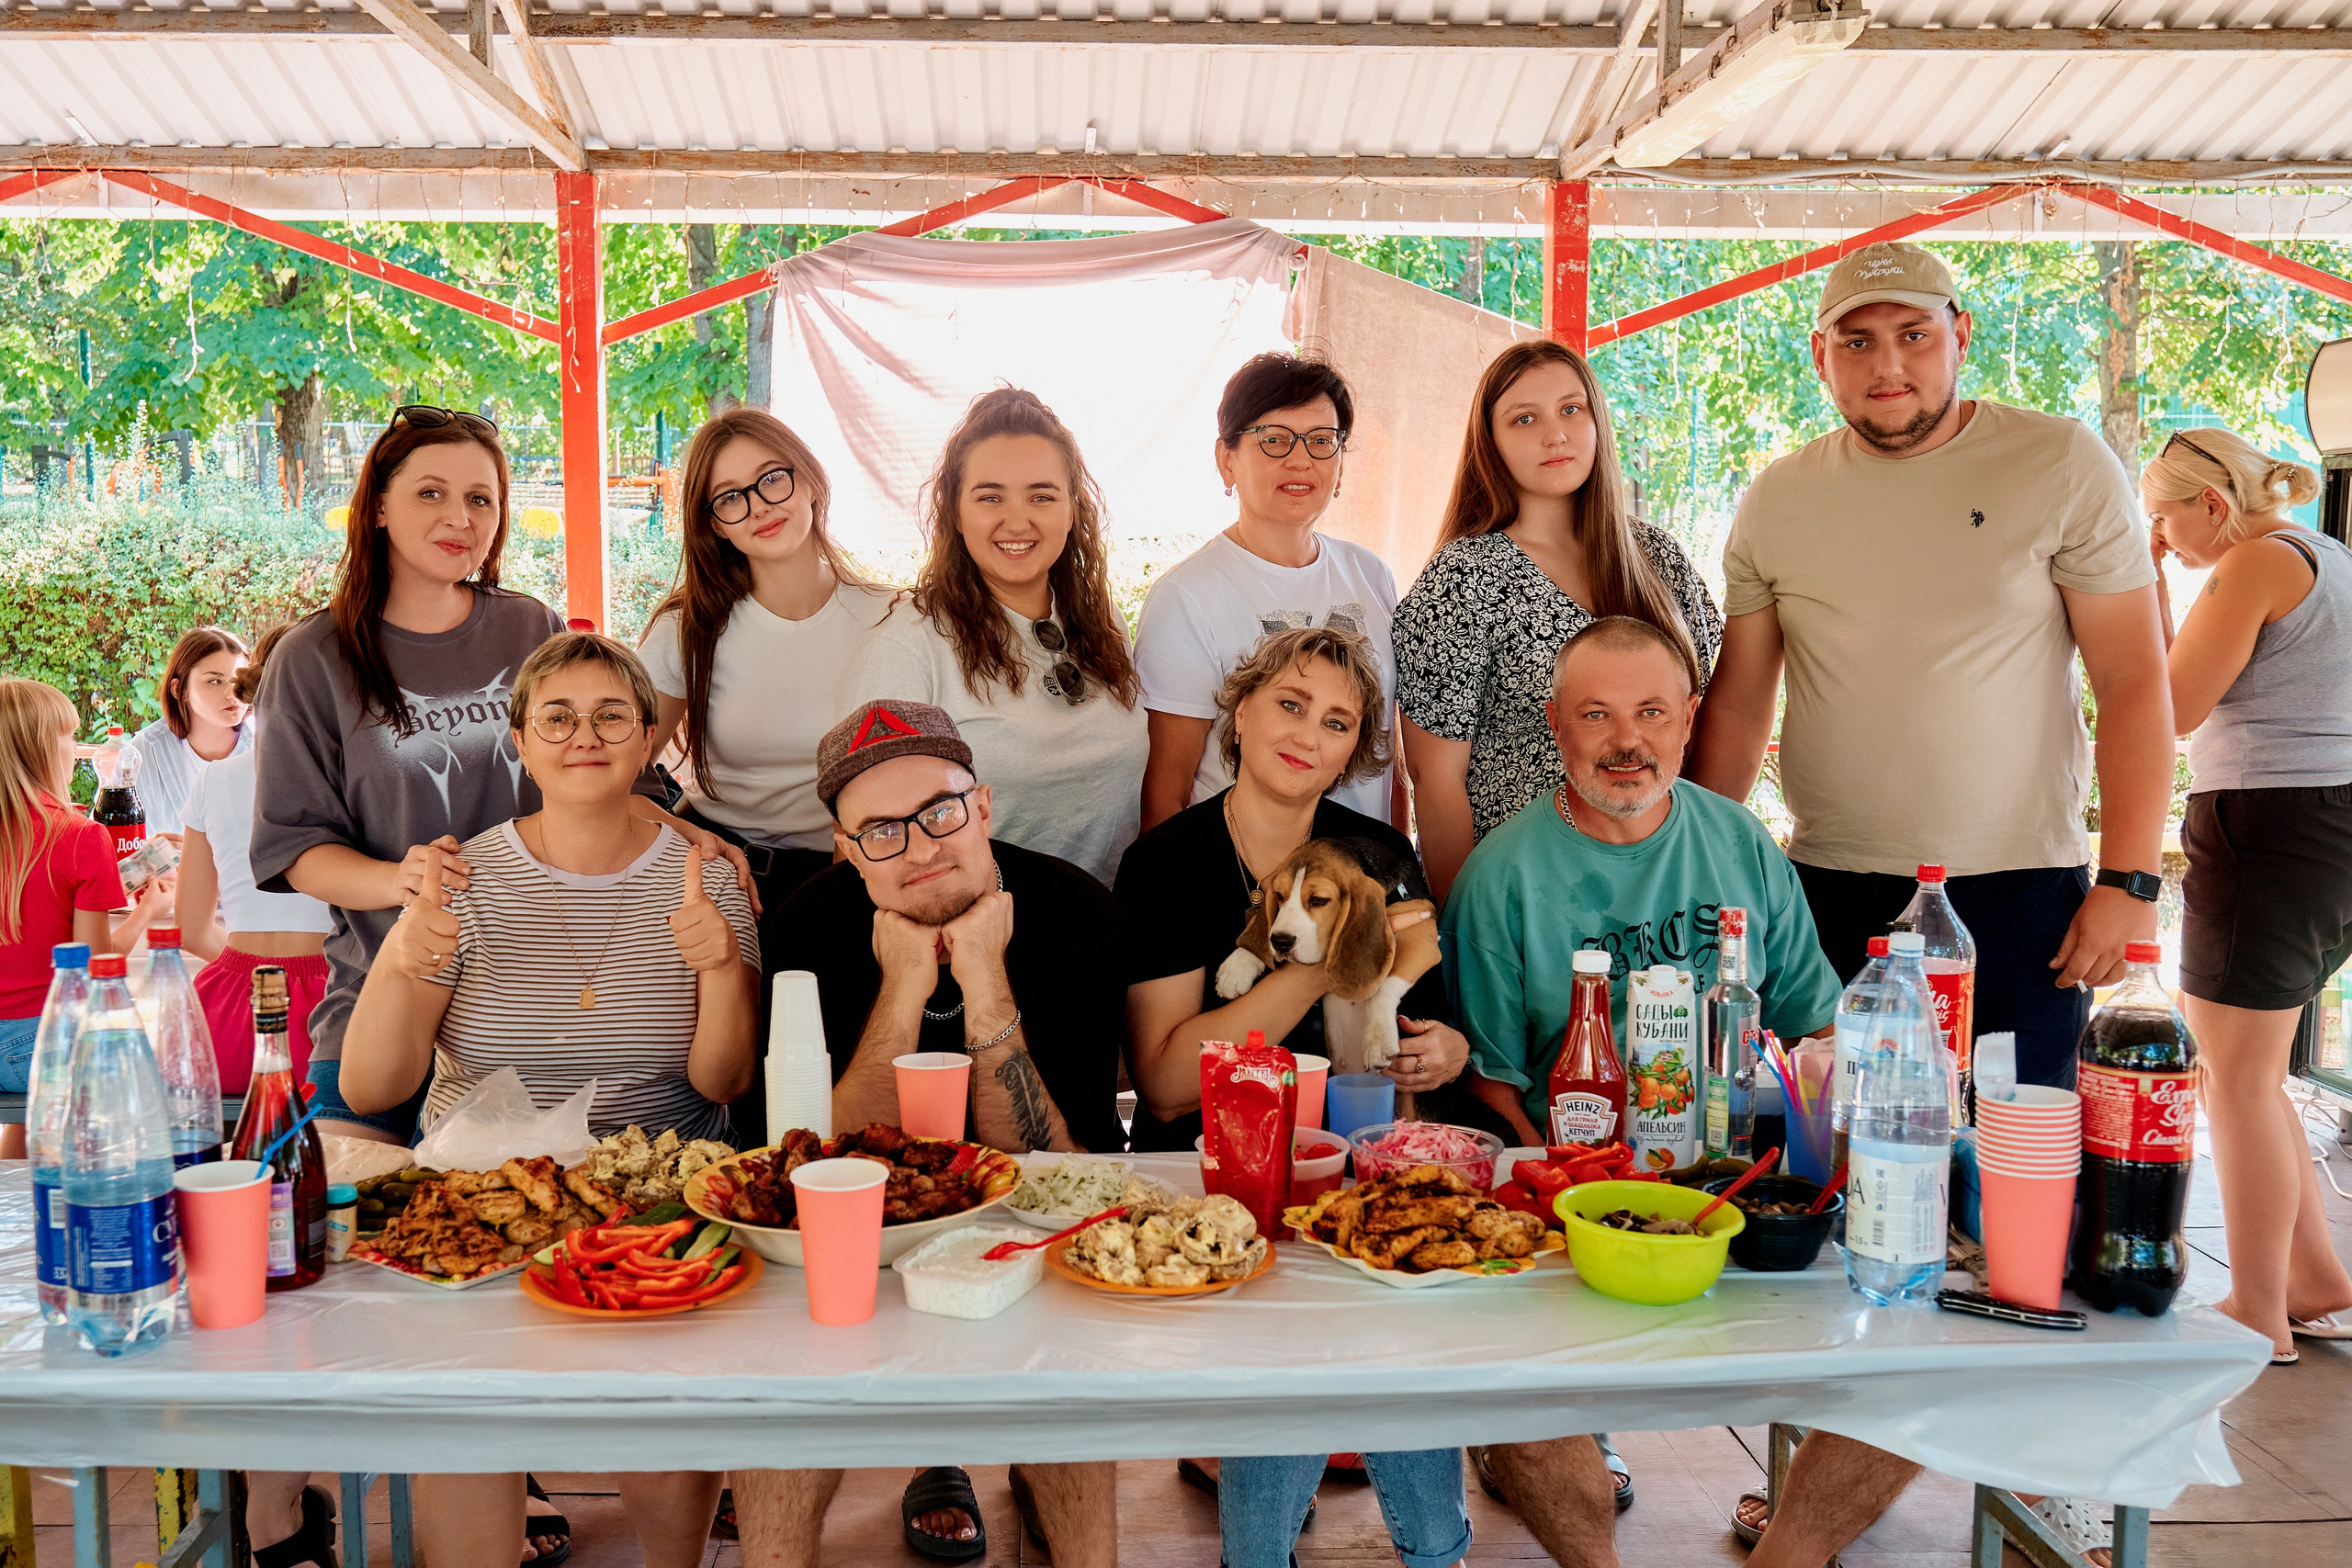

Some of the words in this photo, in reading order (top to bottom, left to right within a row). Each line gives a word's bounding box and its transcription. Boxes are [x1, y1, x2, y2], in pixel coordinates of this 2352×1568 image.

[388, 693, 514, 749] Beyon
[1636, 1004, 1672, 1021] САДЫ
[1636, 1021, 1688, 1039] КУБАНИ
[1566, 1100, 1600, 1115] HEINZ
[1568, 1128, 1596, 1137] КЕТЧУП
[1636, 1121, 1687, 1134] АПЕЛЬСИН
